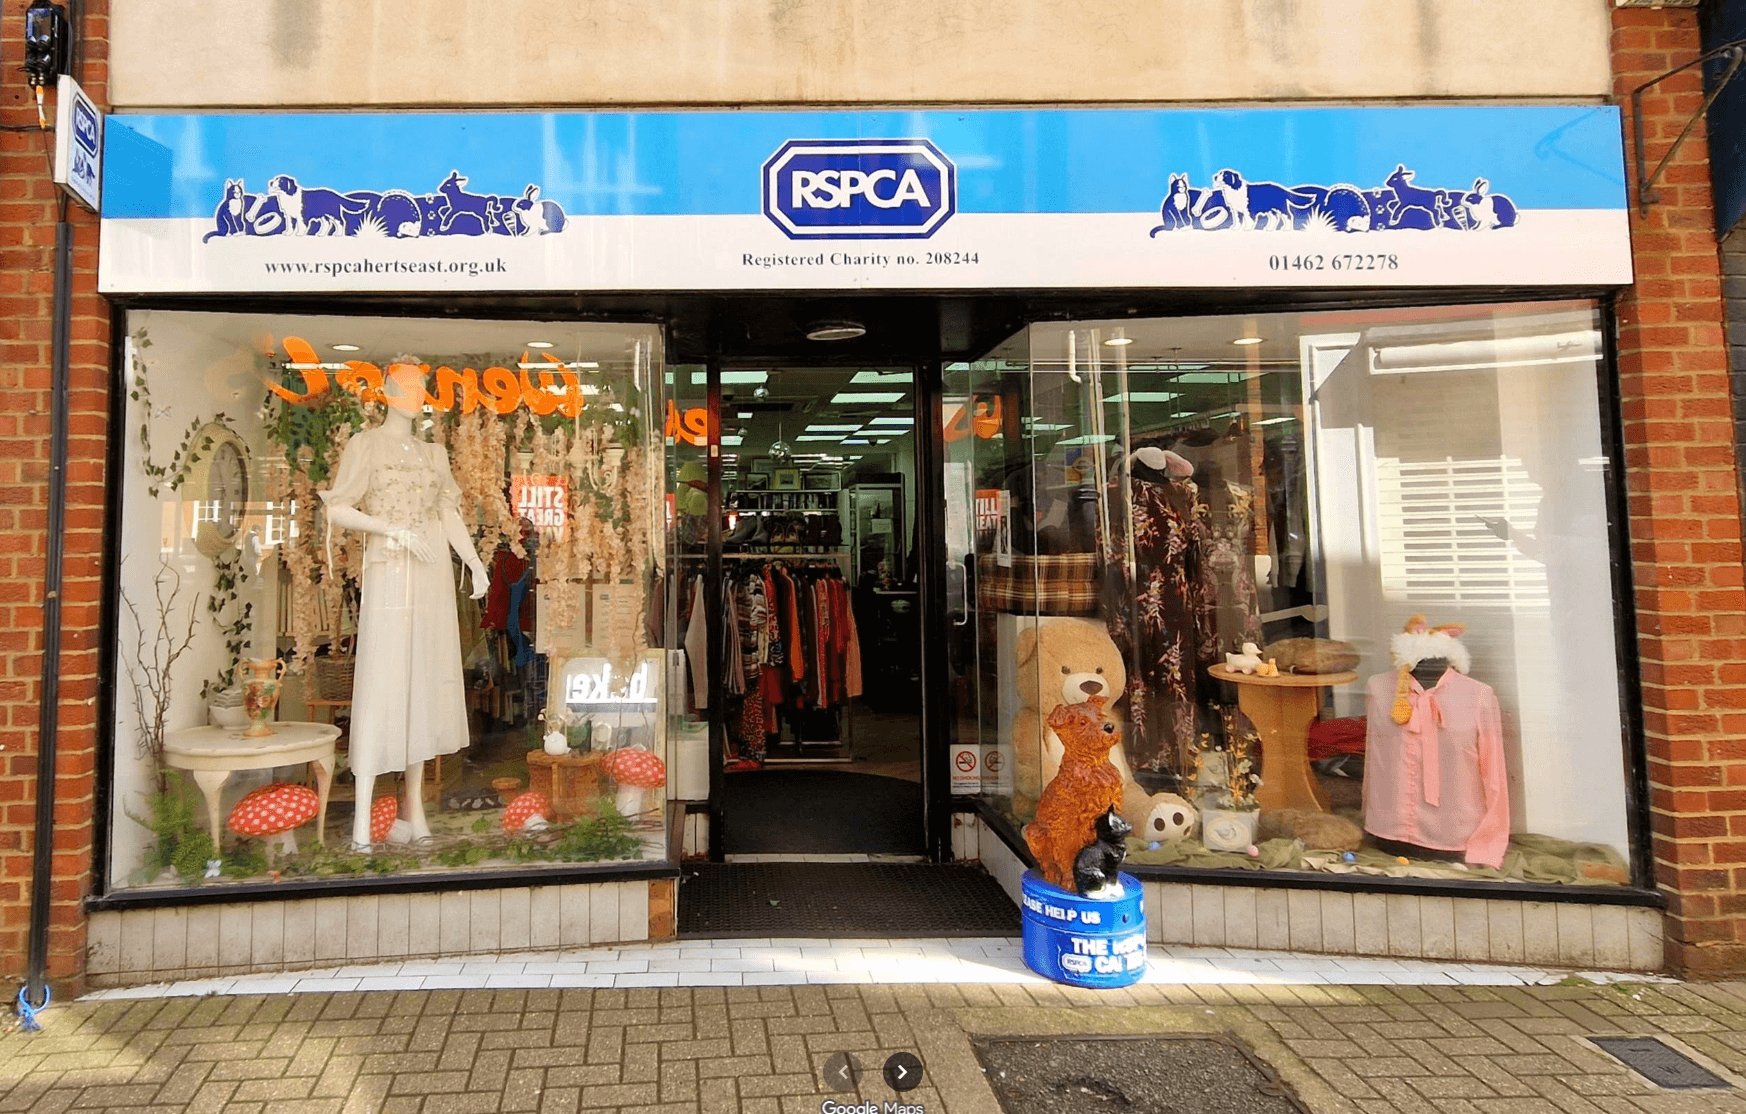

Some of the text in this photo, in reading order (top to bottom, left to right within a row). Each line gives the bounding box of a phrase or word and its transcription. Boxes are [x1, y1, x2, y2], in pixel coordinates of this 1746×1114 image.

[75, 105, 96, 147] RSPCA
[791, 168, 931, 209] RSPCA
[264, 258, 507, 277] www.rspcahertseast.org.uk
[742, 251, 979, 269] Registered Charity no. 208244
[1269, 254, 1399, 270] 01462 672278
[1045, 905, 1077, 921] HELP
[1080, 911, 1101, 924] US
[1071, 937, 1109, 955] THE
